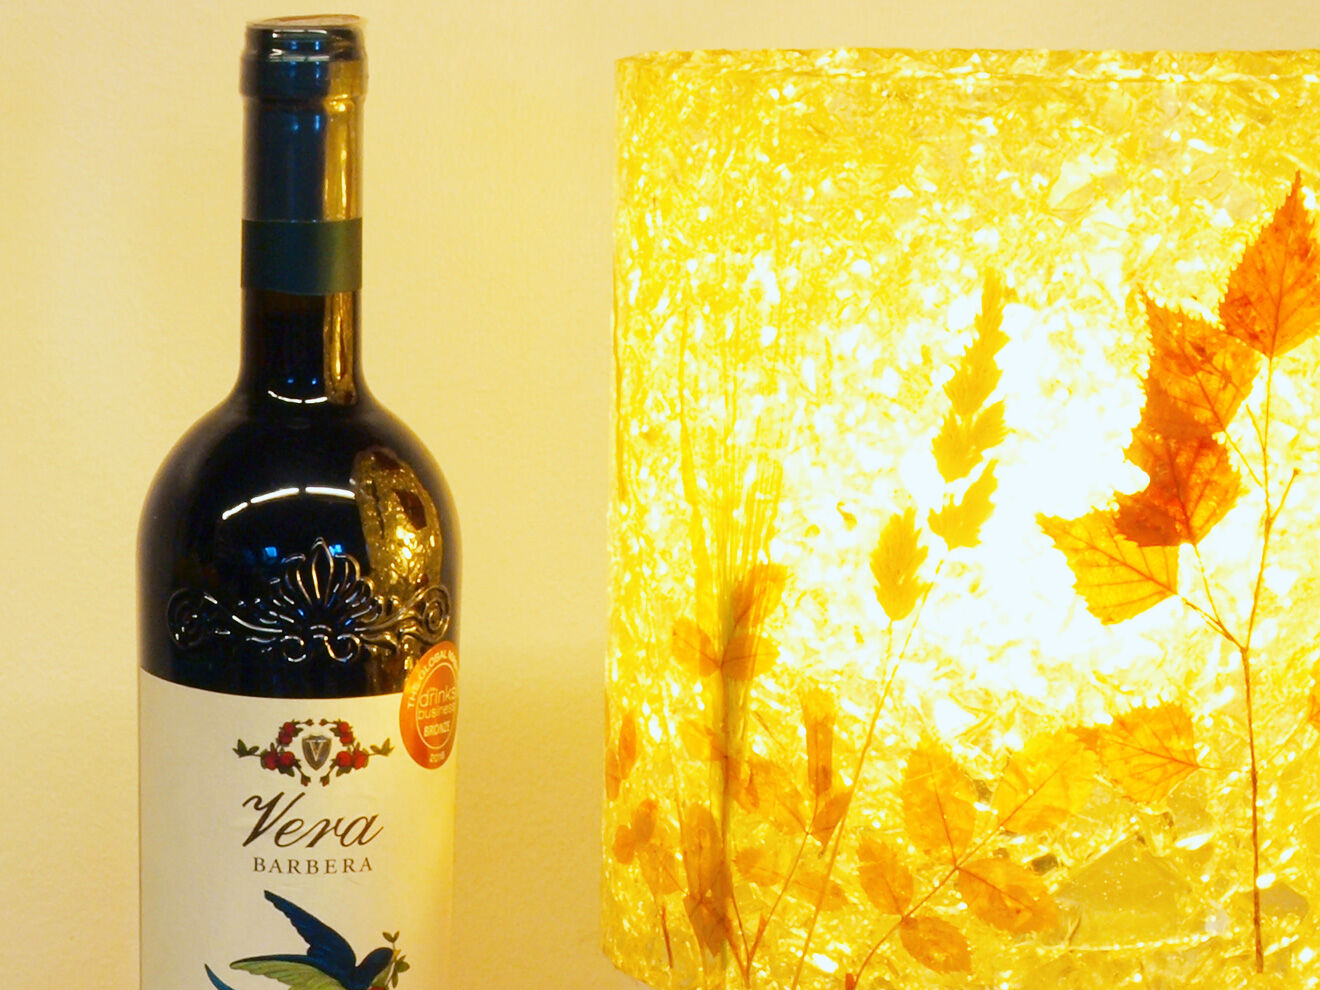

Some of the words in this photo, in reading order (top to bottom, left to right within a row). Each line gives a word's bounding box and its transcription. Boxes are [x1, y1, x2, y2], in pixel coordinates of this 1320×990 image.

[418, 649, 448, 680] GLOBAL
[418, 685, 456, 707] drinks
[423, 720, 451, 738] BRONZE
[242, 791, 385, 849] Vera
[253, 856, 373, 875] BARBERA
